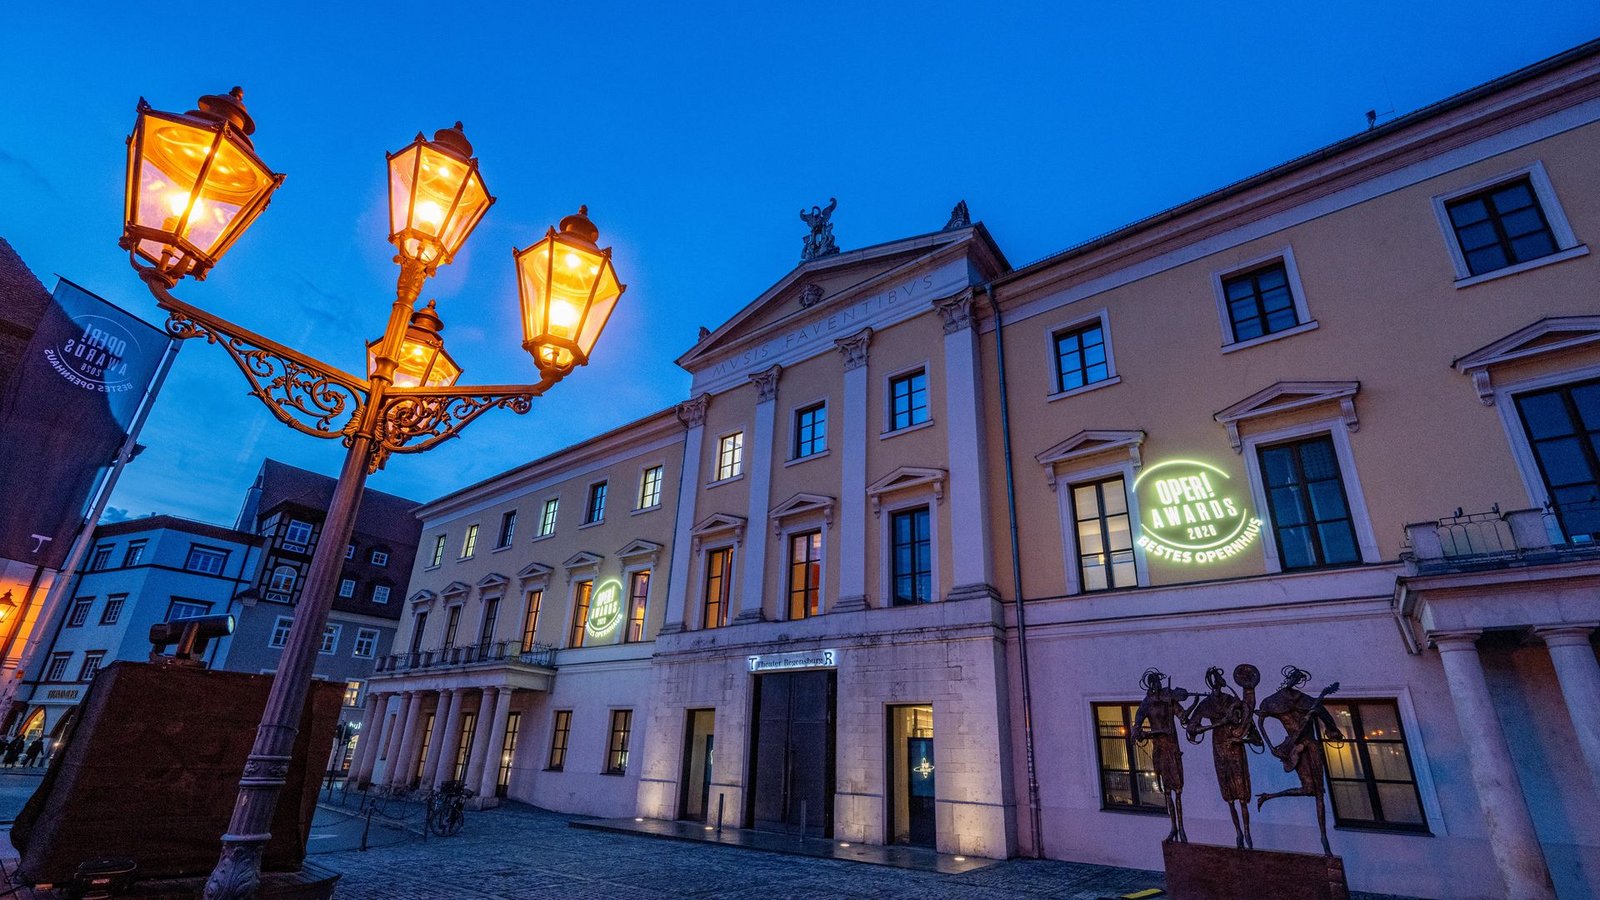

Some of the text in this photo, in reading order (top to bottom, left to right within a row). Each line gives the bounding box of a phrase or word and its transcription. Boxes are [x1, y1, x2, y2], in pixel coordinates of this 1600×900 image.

[712, 274, 934, 378] MVSIS FAVENTIBVS
[1155, 472, 1216, 505] OPER!
[1151, 497, 1239, 529] AWARDS
[1136, 516, 1264, 564] BESTES OPERNHAUS
